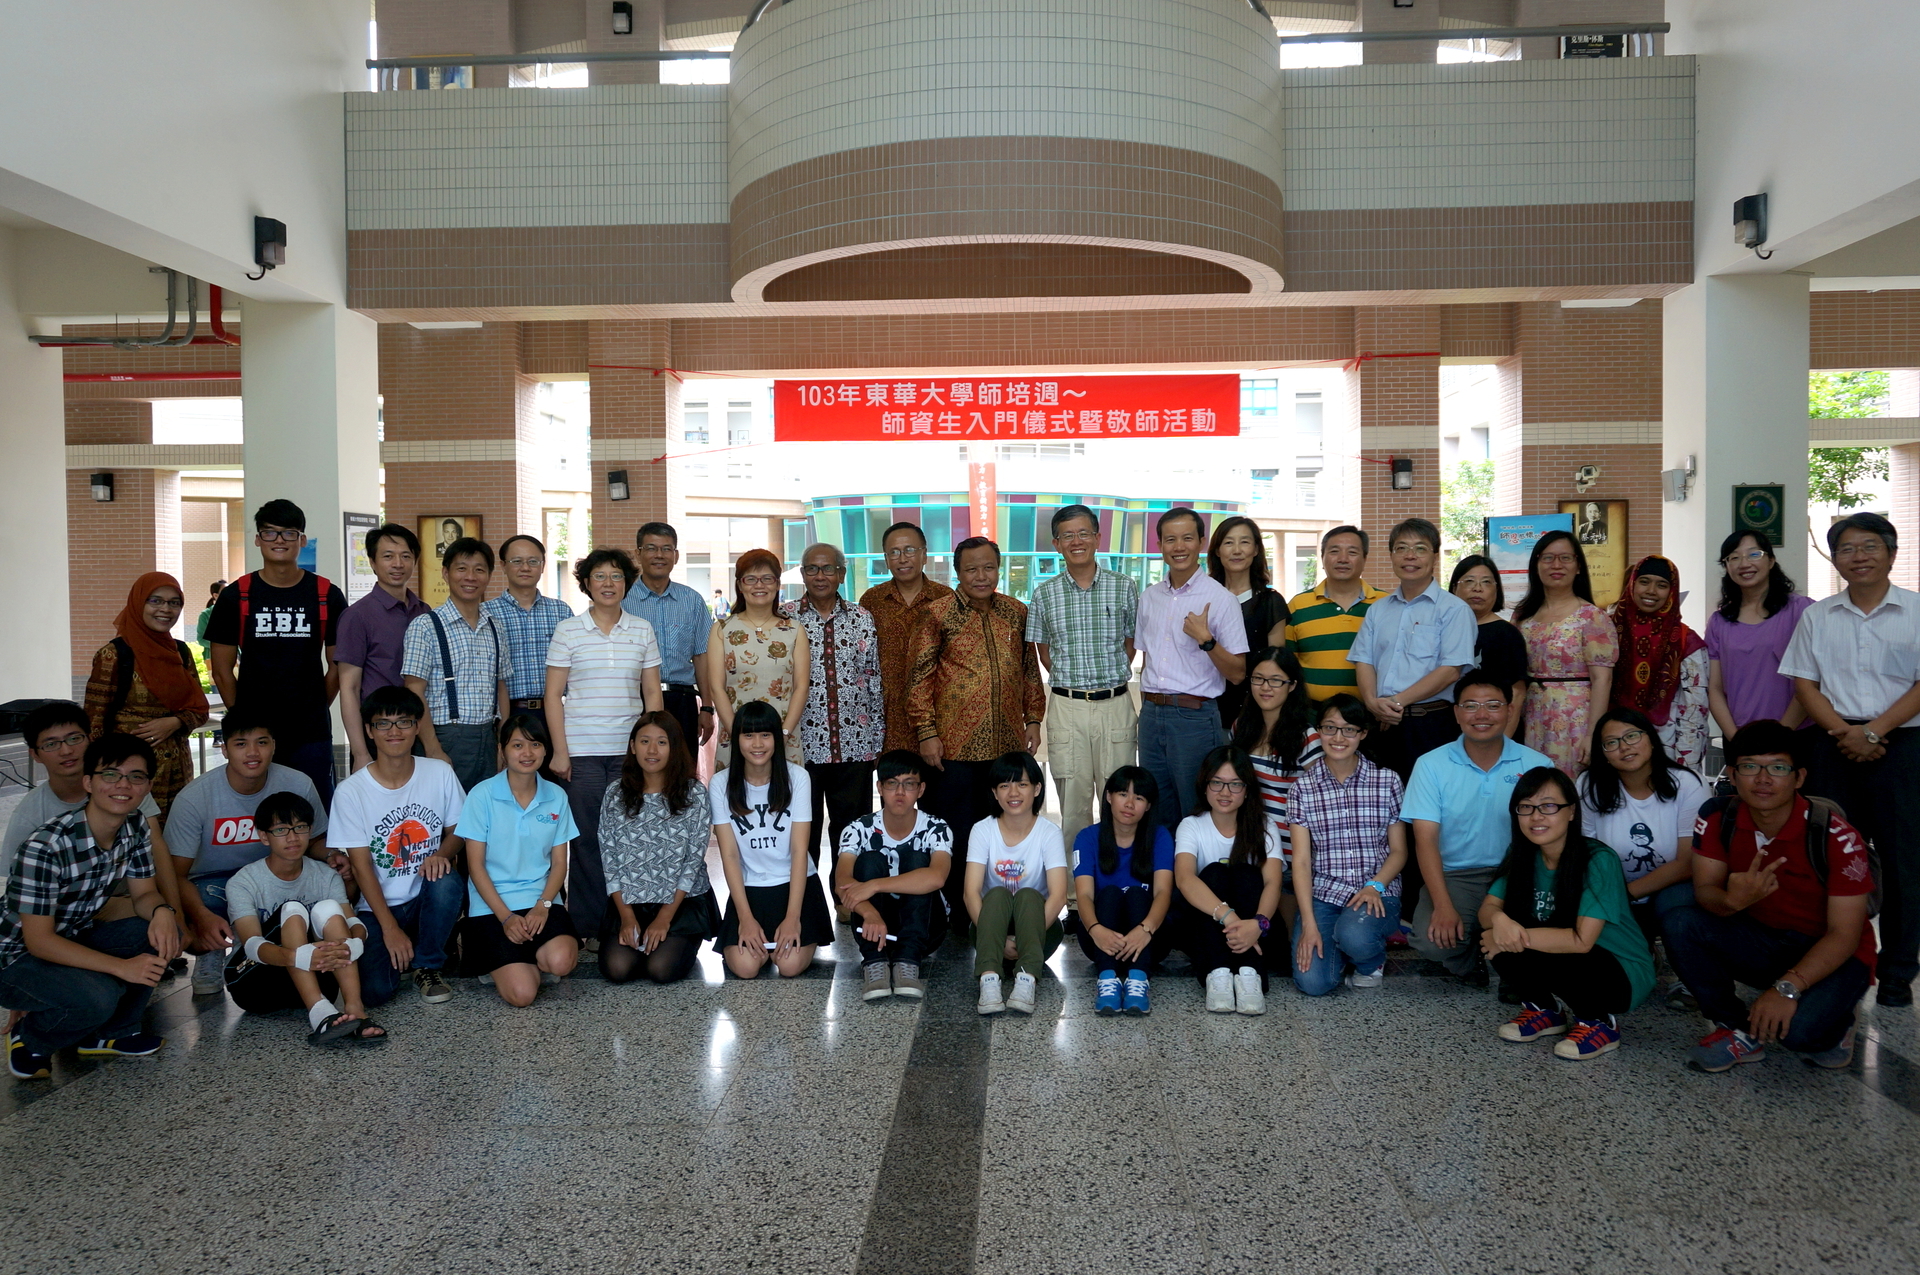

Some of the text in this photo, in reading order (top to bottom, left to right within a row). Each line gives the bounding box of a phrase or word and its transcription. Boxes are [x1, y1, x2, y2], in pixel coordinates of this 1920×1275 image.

[881, 408, 1217, 436] 師資生入門儀式暨敬師活動
[255, 613, 311, 633] EBL
[374, 803, 443, 838] SUNSHINE
[729, 803, 791, 836] NYC
[750, 836, 777, 849] CITY
[396, 866, 411, 878] THE
[997, 863, 1025, 873] RAINY
